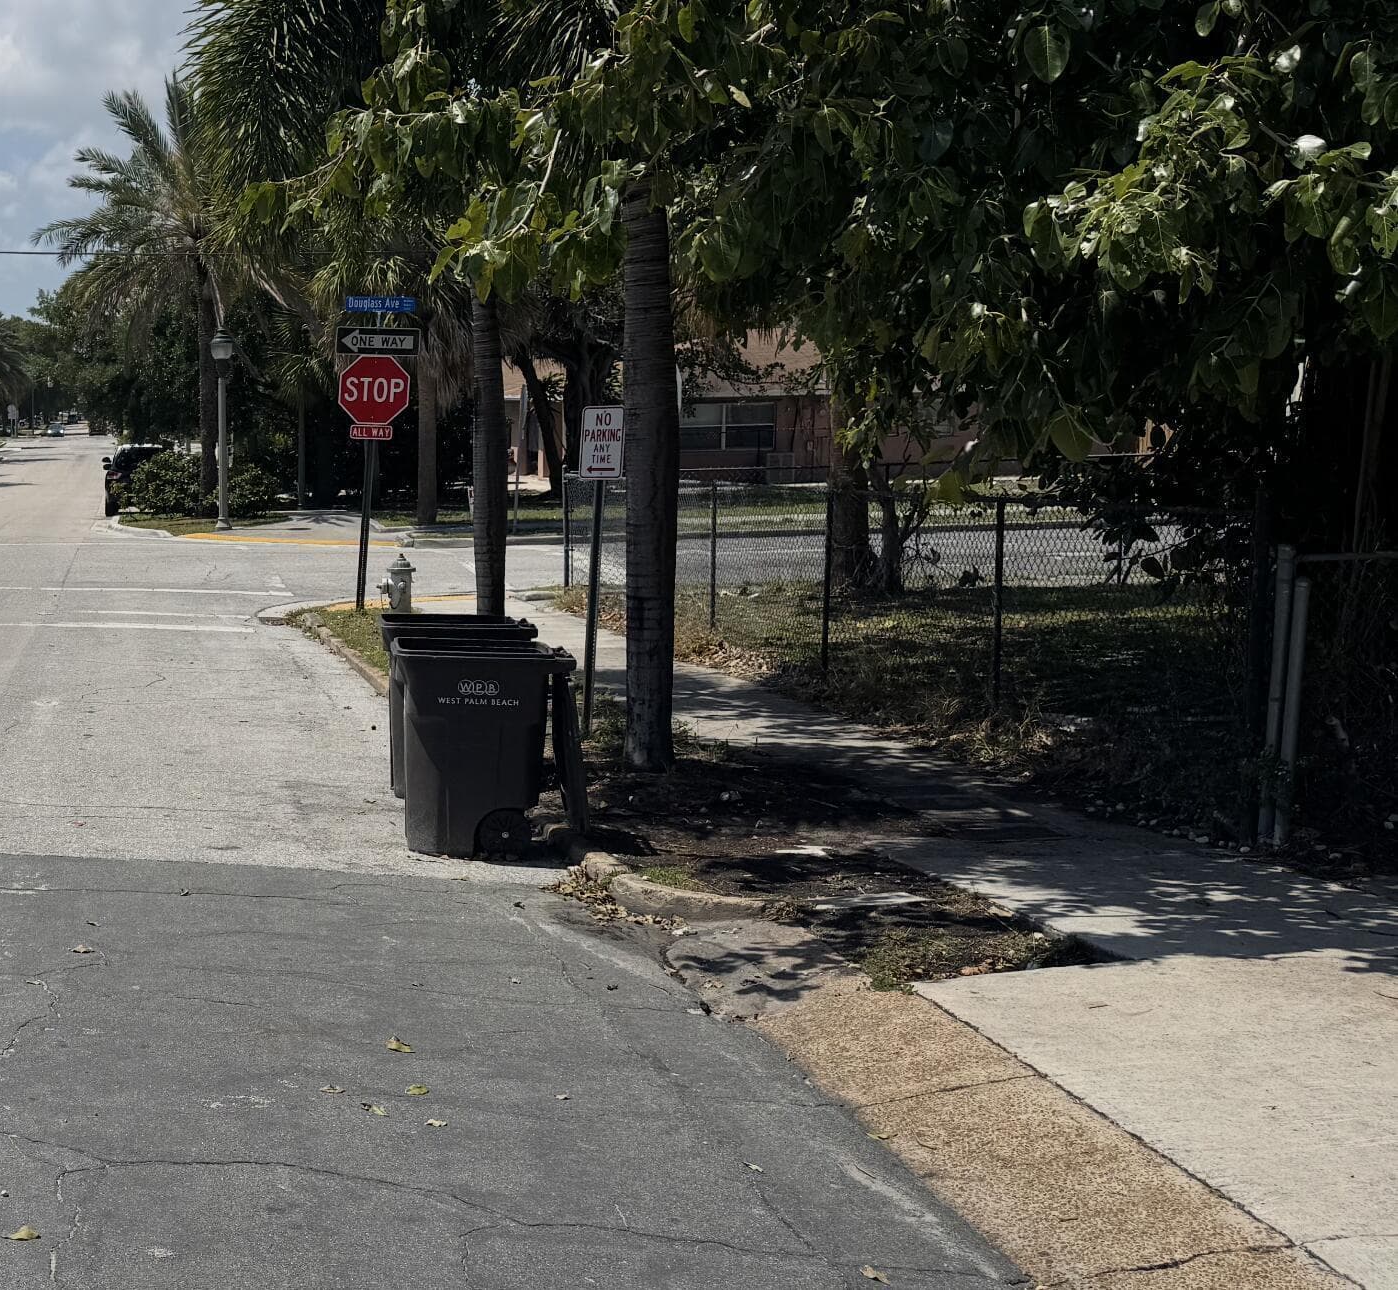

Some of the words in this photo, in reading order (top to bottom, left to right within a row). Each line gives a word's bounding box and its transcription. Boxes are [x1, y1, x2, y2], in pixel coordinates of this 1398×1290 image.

[348, 296, 382, 311] Douglass
[385, 298, 400, 309] Ave
[351, 335, 375, 347] ONE
[381, 336, 407, 348] WAY
[344, 376, 405, 403] STOP
[595, 412, 612, 427] NO
[352, 427, 367, 437] ALL
[371, 427, 391, 437] WAY
[584, 428, 622, 443] PARKING
[593, 443, 611, 453] ANY
[591, 454, 612, 464] TIME
[459, 681, 497, 694] WPB
[438, 696, 460, 705] WEST
[464, 697, 488, 706] PALM
[491, 698, 520, 707] BEACH
